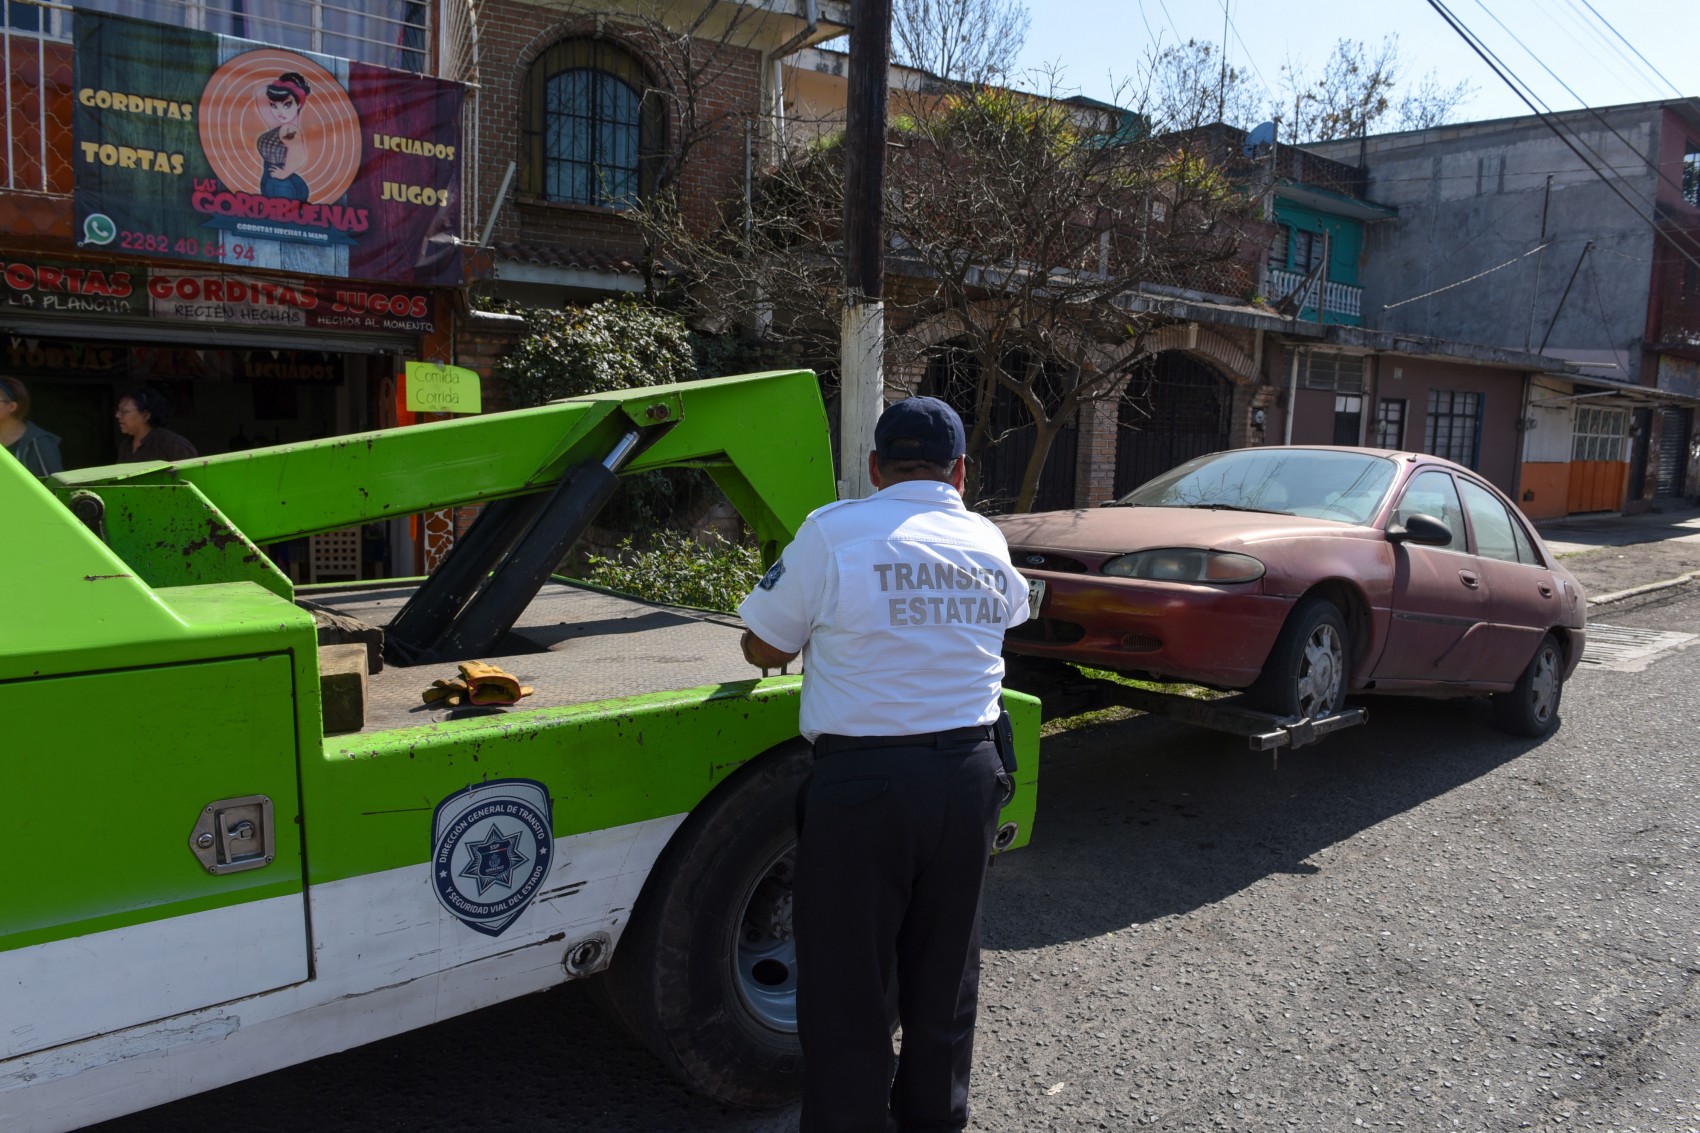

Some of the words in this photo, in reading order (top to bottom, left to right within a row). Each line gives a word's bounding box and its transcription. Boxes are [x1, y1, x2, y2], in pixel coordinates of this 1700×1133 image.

[78, 87, 193, 121] GORDITAS
[80, 141, 185, 175] TORTAS
[373, 133, 455, 161] LICUADOS
[193, 177, 217, 192] LAS
[380, 181, 448, 207] JUGOS
[191, 190, 369, 232] GORDIBUENAS
[236, 223, 273, 233] GORDITAS
[273, 227, 302, 237] HECHAS
[308, 232, 328, 241] MANO
[120, 230, 169, 253] 2282
[174, 238, 199, 256] 40
[204, 241, 227, 258] 64
[232, 244, 255, 262] 94
[8, 293, 35, 307] LA
[43, 295, 132, 313] PLANCHA
[147, 275, 319, 310] GORDITAS
[331, 291, 428, 318] JUGOS
[241, 308, 300, 322] HECHAS
[317, 315, 361, 327] HECHOS
[364, 317, 380, 328] AL
[383, 319, 433, 332] MOMENTO
[244, 361, 335, 382] LICUADOS
[414, 365, 460, 384] Comida
[415, 387, 459, 405] Corrida
[873, 562, 1008, 596] TRANSITO
[888, 597, 1002, 627] ESTATAL
[439, 820, 468, 863] DIRECCIÓN
[468, 804, 505, 823] GENERAL
[506, 804, 518, 814] DE
[518, 807, 545, 840] TRÁNSITO
[445, 886, 453, 895] Y
[521, 865, 543, 895] ESTADO
[448, 891, 489, 914] SEGURIDAD
[490, 903, 508, 914] VIAL
[508, 894, 524, 907] DEL
